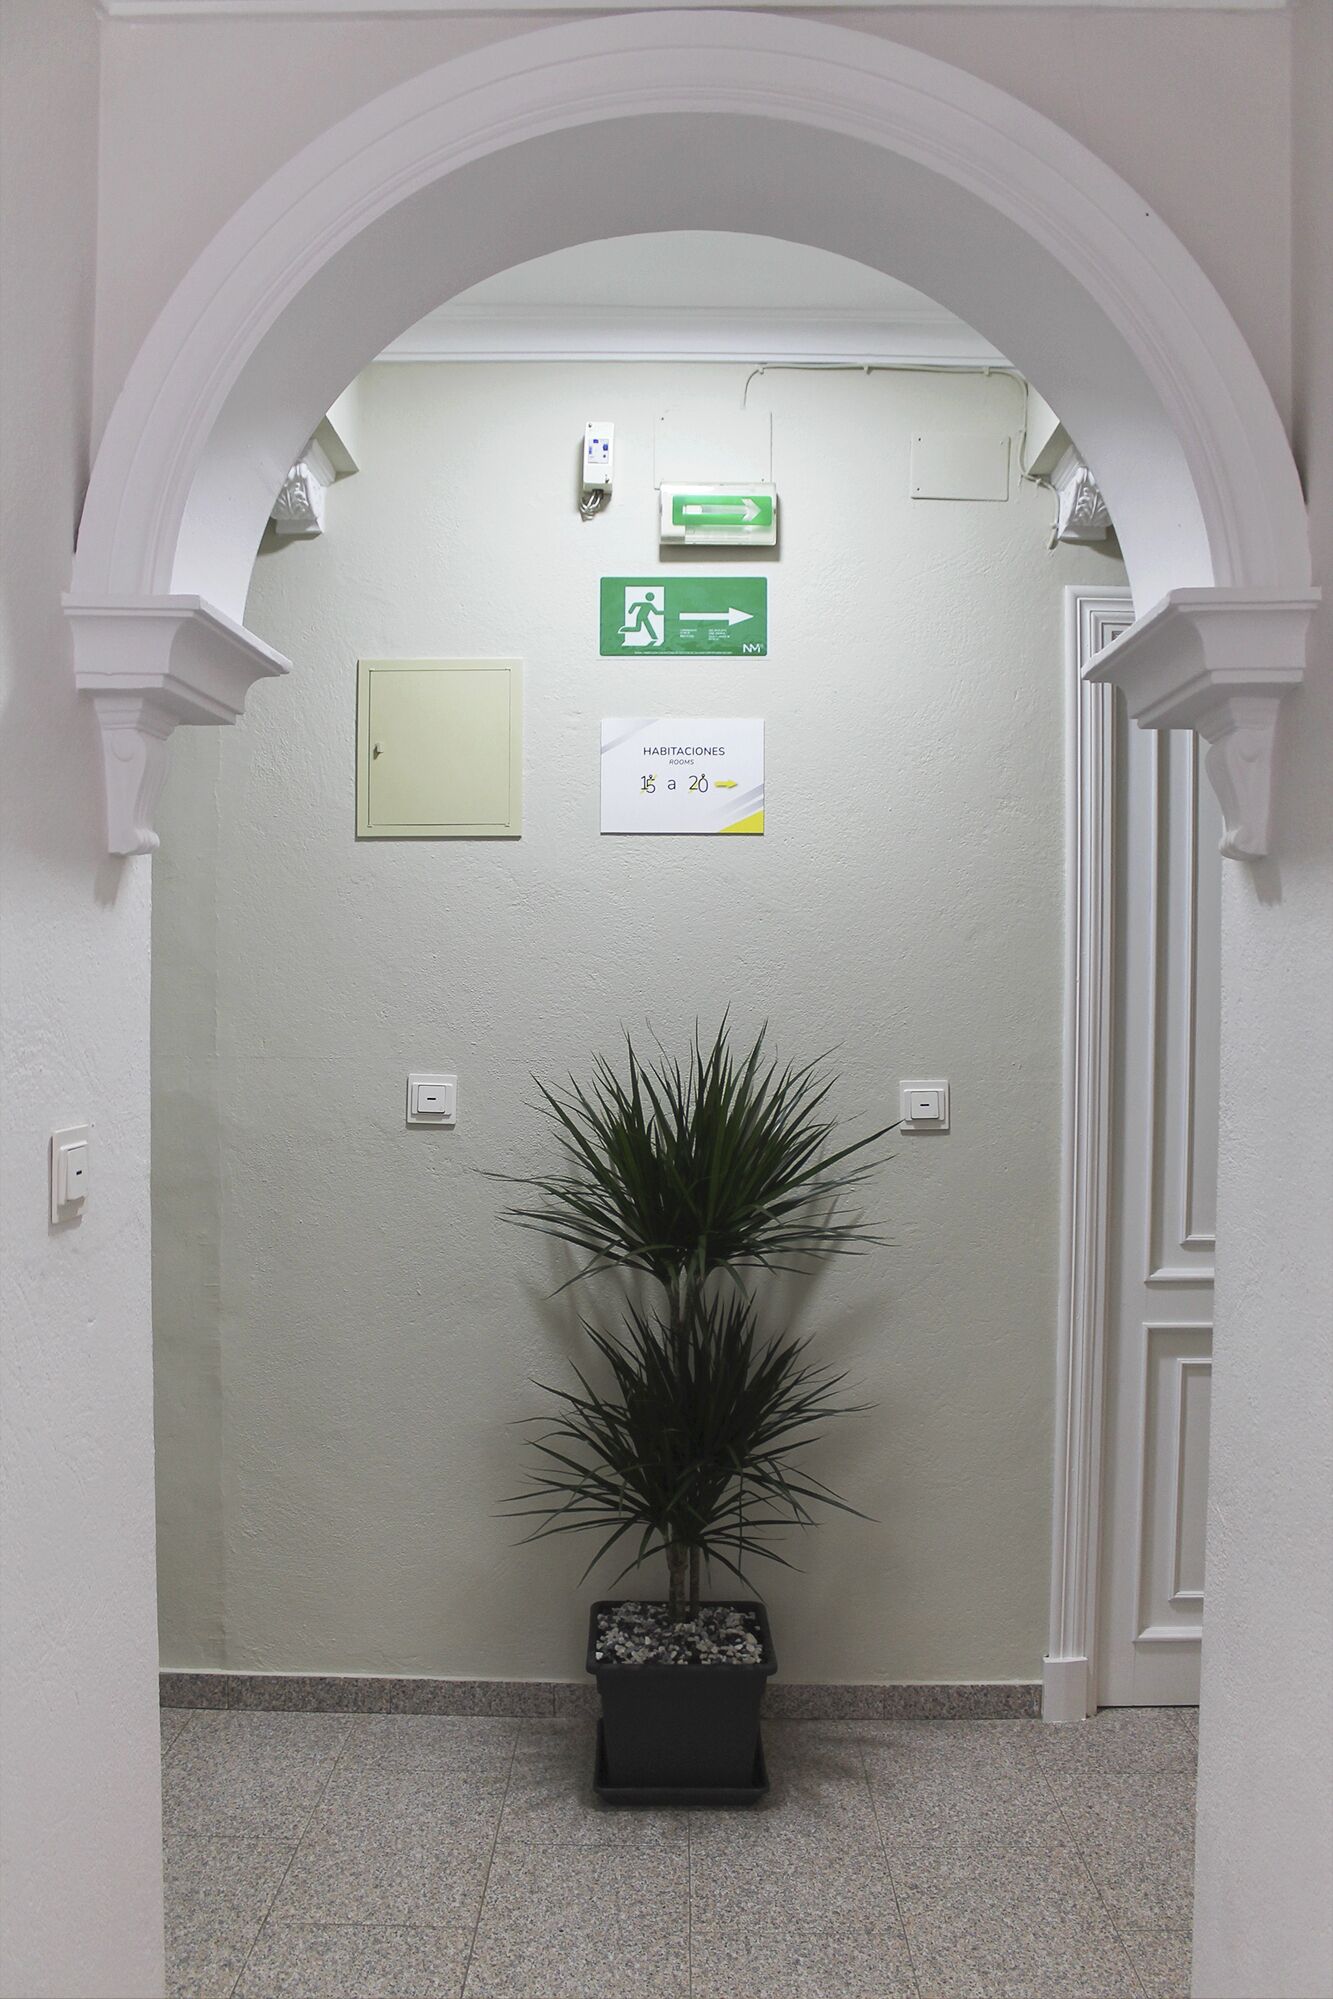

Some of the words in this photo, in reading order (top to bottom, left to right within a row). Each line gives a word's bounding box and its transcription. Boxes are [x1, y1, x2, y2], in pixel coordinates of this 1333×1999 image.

[643, 746, 726, 756] HABITACIONES
[641, 774, 656, 794] 15
[667, 779, 677, 790] a
[688, 773, 709, 793] 20
